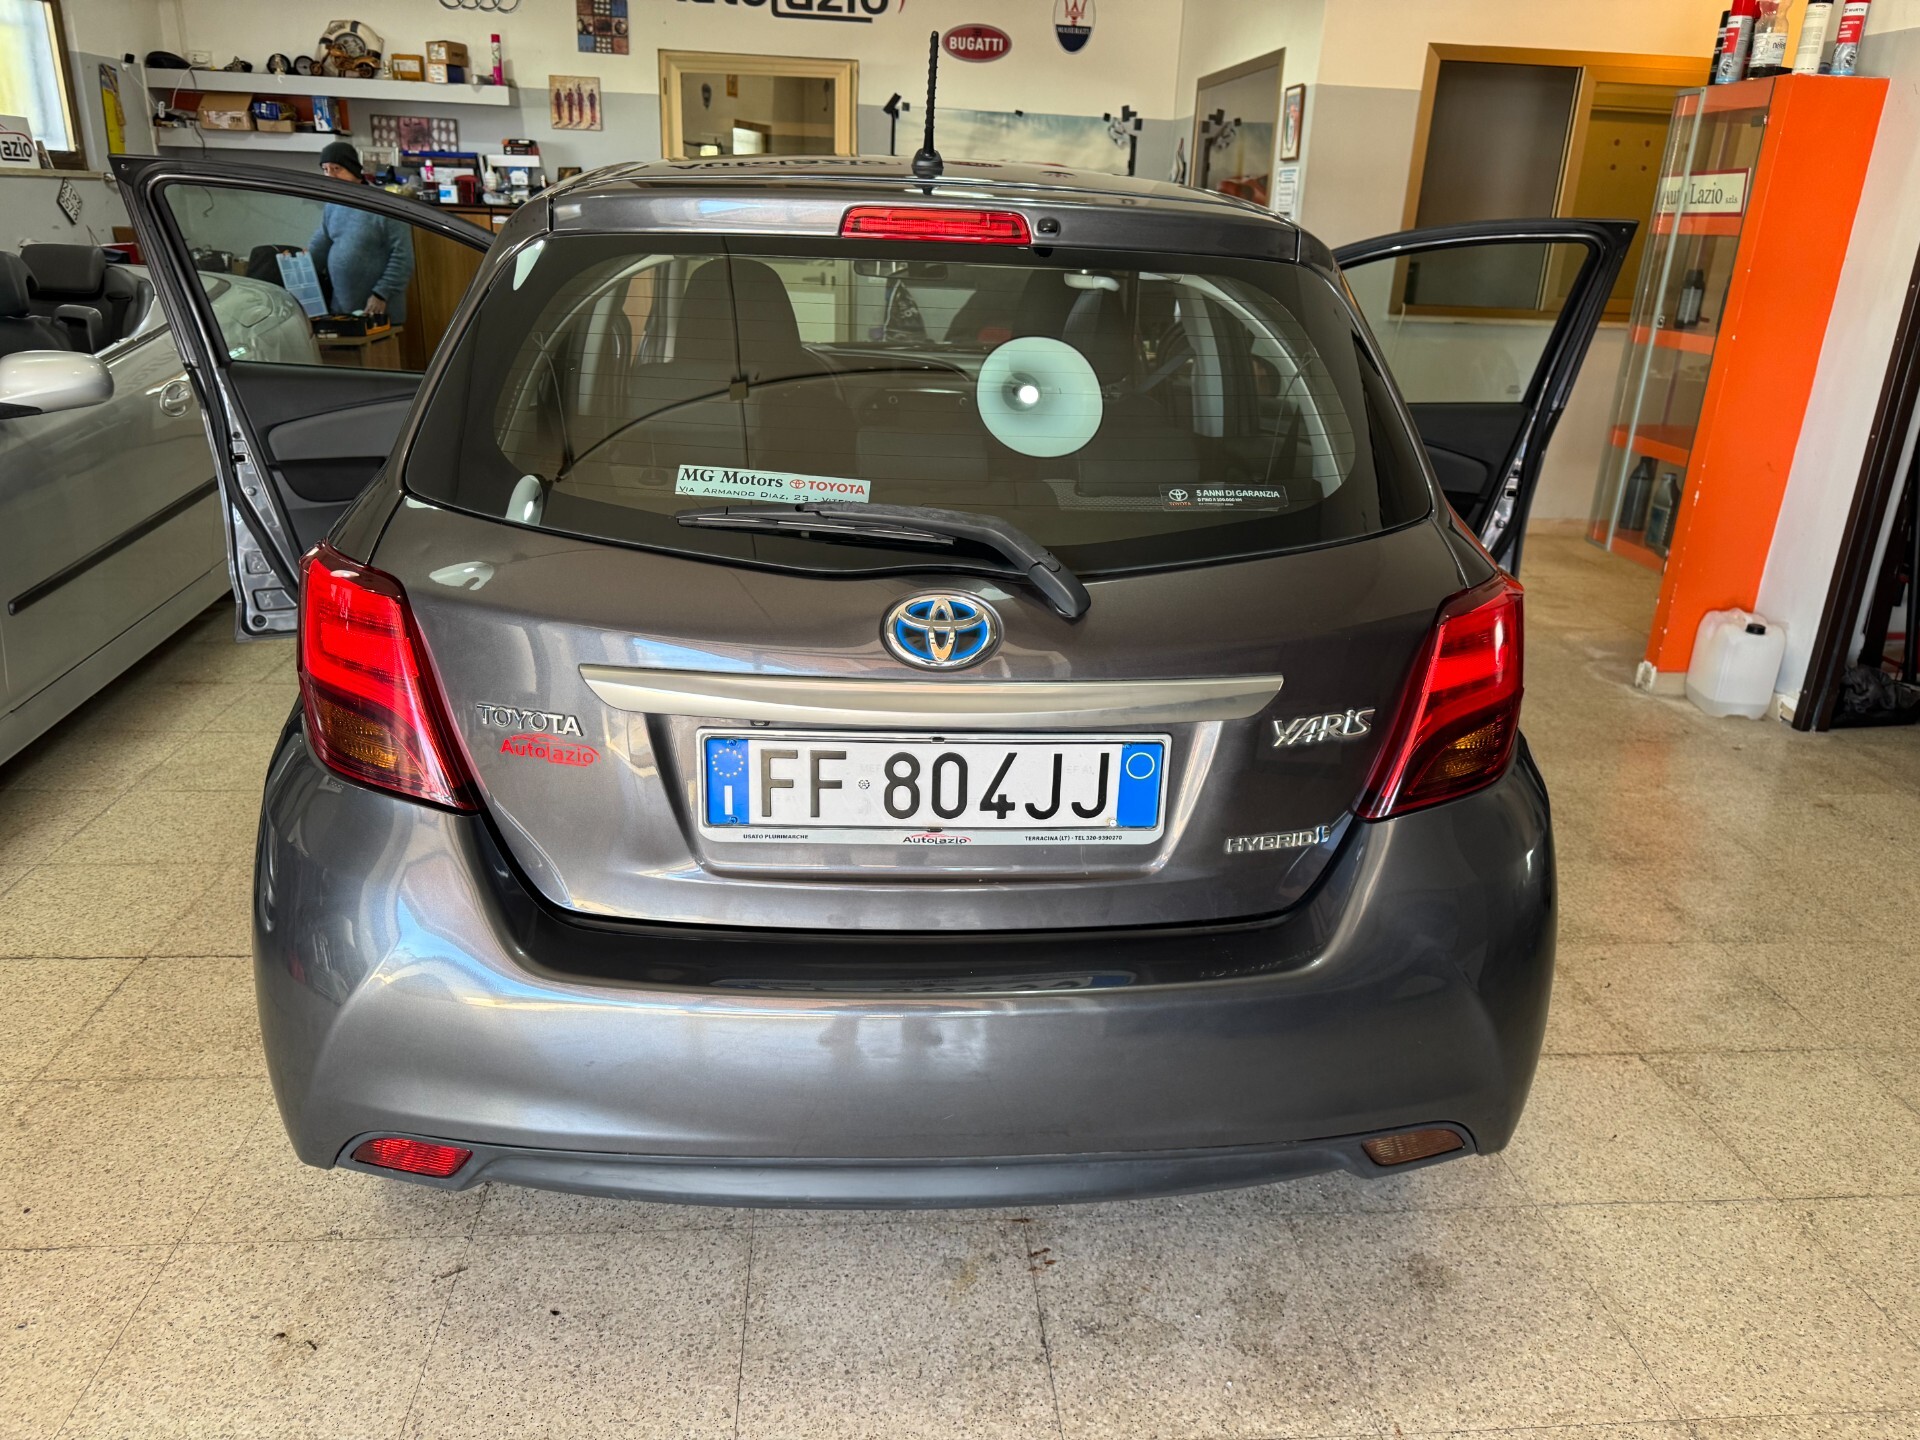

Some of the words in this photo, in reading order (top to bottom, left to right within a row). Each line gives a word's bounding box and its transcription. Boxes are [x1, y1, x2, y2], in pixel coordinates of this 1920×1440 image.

[950, 36, 1003, 51] BUGATTI
[1689, 182, 1723, 205] Lazio
[679, 485, 695, 493] VIA
[702, 487, 756, 497] ARMANDO
[794, 494, 809, 502] 23
[680, 468, 715, 482] MG
[720, 470, 783, 488] Motors
[808, 480, 865, 495] TOYOTA
[1196, 489, 1202, 497] 5
[1203, 489, 1225, 497] ANNI
[1226, 489, 1235, 497] DI
[1236, 490, 1280, 498] GARANZIA
[477, 702, 584, 737] TOYOTA
[500, 739, 595, 767] Autolazio
[760, 749, 847, 818] FF
[883, 751, 1110, 821] 804JJ
[723, 784, 734, 816] I
[902, 836, 968, 845] Autolazio
[1225, 829, 1315, 853] HYBRID
